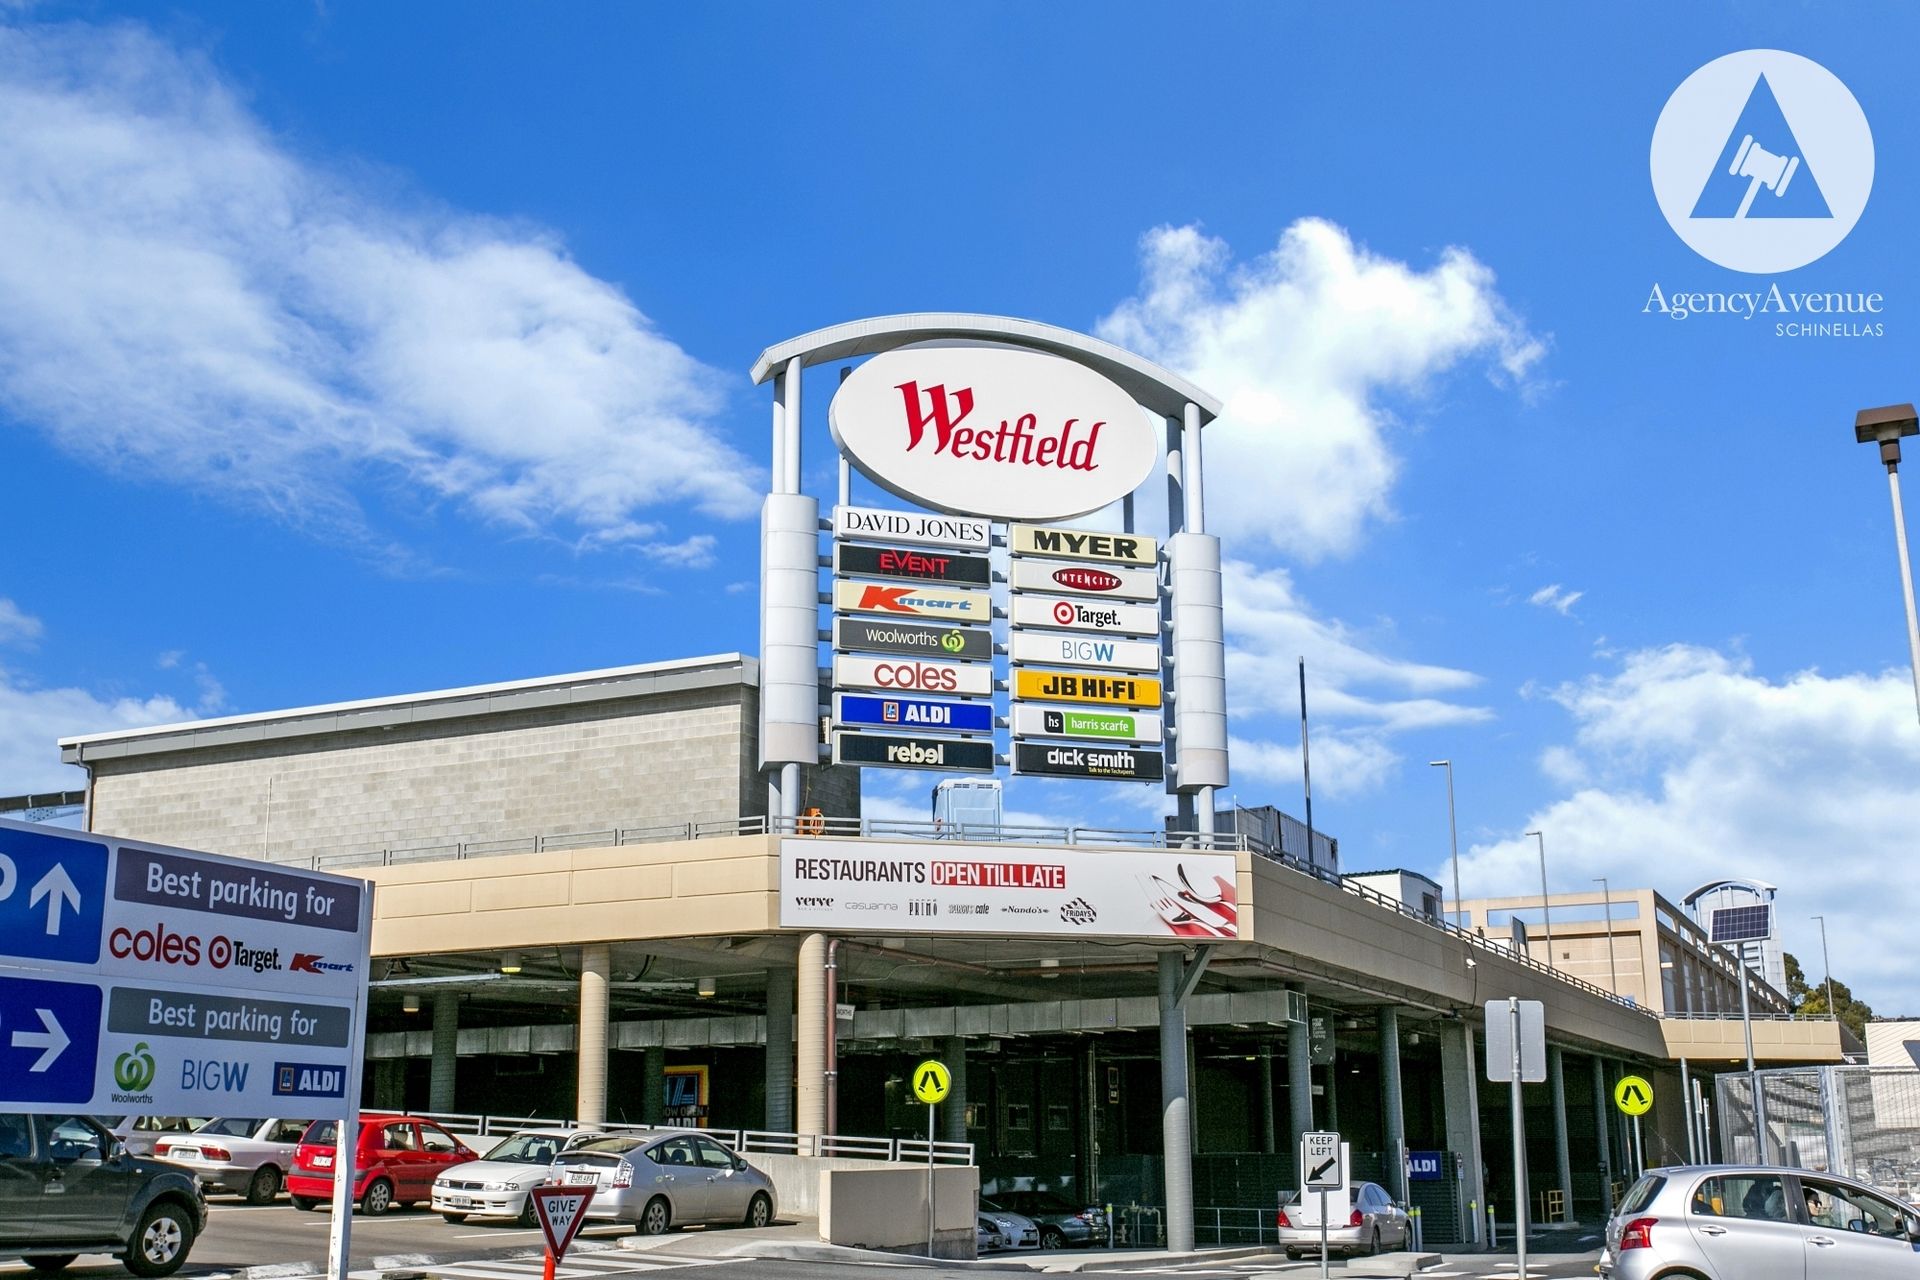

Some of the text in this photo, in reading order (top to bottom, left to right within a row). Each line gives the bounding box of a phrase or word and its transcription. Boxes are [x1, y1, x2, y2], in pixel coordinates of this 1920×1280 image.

[894, 380, 1107, 472] Westfield
[846, 511, 984, 541] DAVID JONES
[1034, 530, 1138, 559] MYER
[880, 549, 951, 573] EVENT
[1055, 572, 1120, 587] INTENCITY
[858, 585, 973, 613] Kmart
[866, 628, 938, 647] Woolworths
[873, 662, 957, 691] coles
[1042, 676, 1077, 696] JB
[904, 704, 951, 724] ALDI
[1048, 715, 1129, 732] hs harris scarfe
[888, 742, 944, 765] rebel
[1047, 748, 1135, 769] dick smith
[795, 858, 1063, 888] RESTAURANTS OPEN TILL LATE
[147, 862, 336, 920] Best parking for
[795, 896, 834, 907] verve
[1007, 905, 1043, 914] Nando's
[109, 923, 201, 966] coles
[289, 953, 355, 974] Kmart
[148, 998, 318, 1040] Best parking for
[298, 1069, 341, 1093] ALDI
[111, 1092, 153, 1104] Woolworths
[1309, 1136, 1333, 1145] KEEP
[1310, 1147, 1332, 1156] LEFT
[548, 1199, 577, 1213] GIVE
[551, 1215, 572, 1226] WAY
